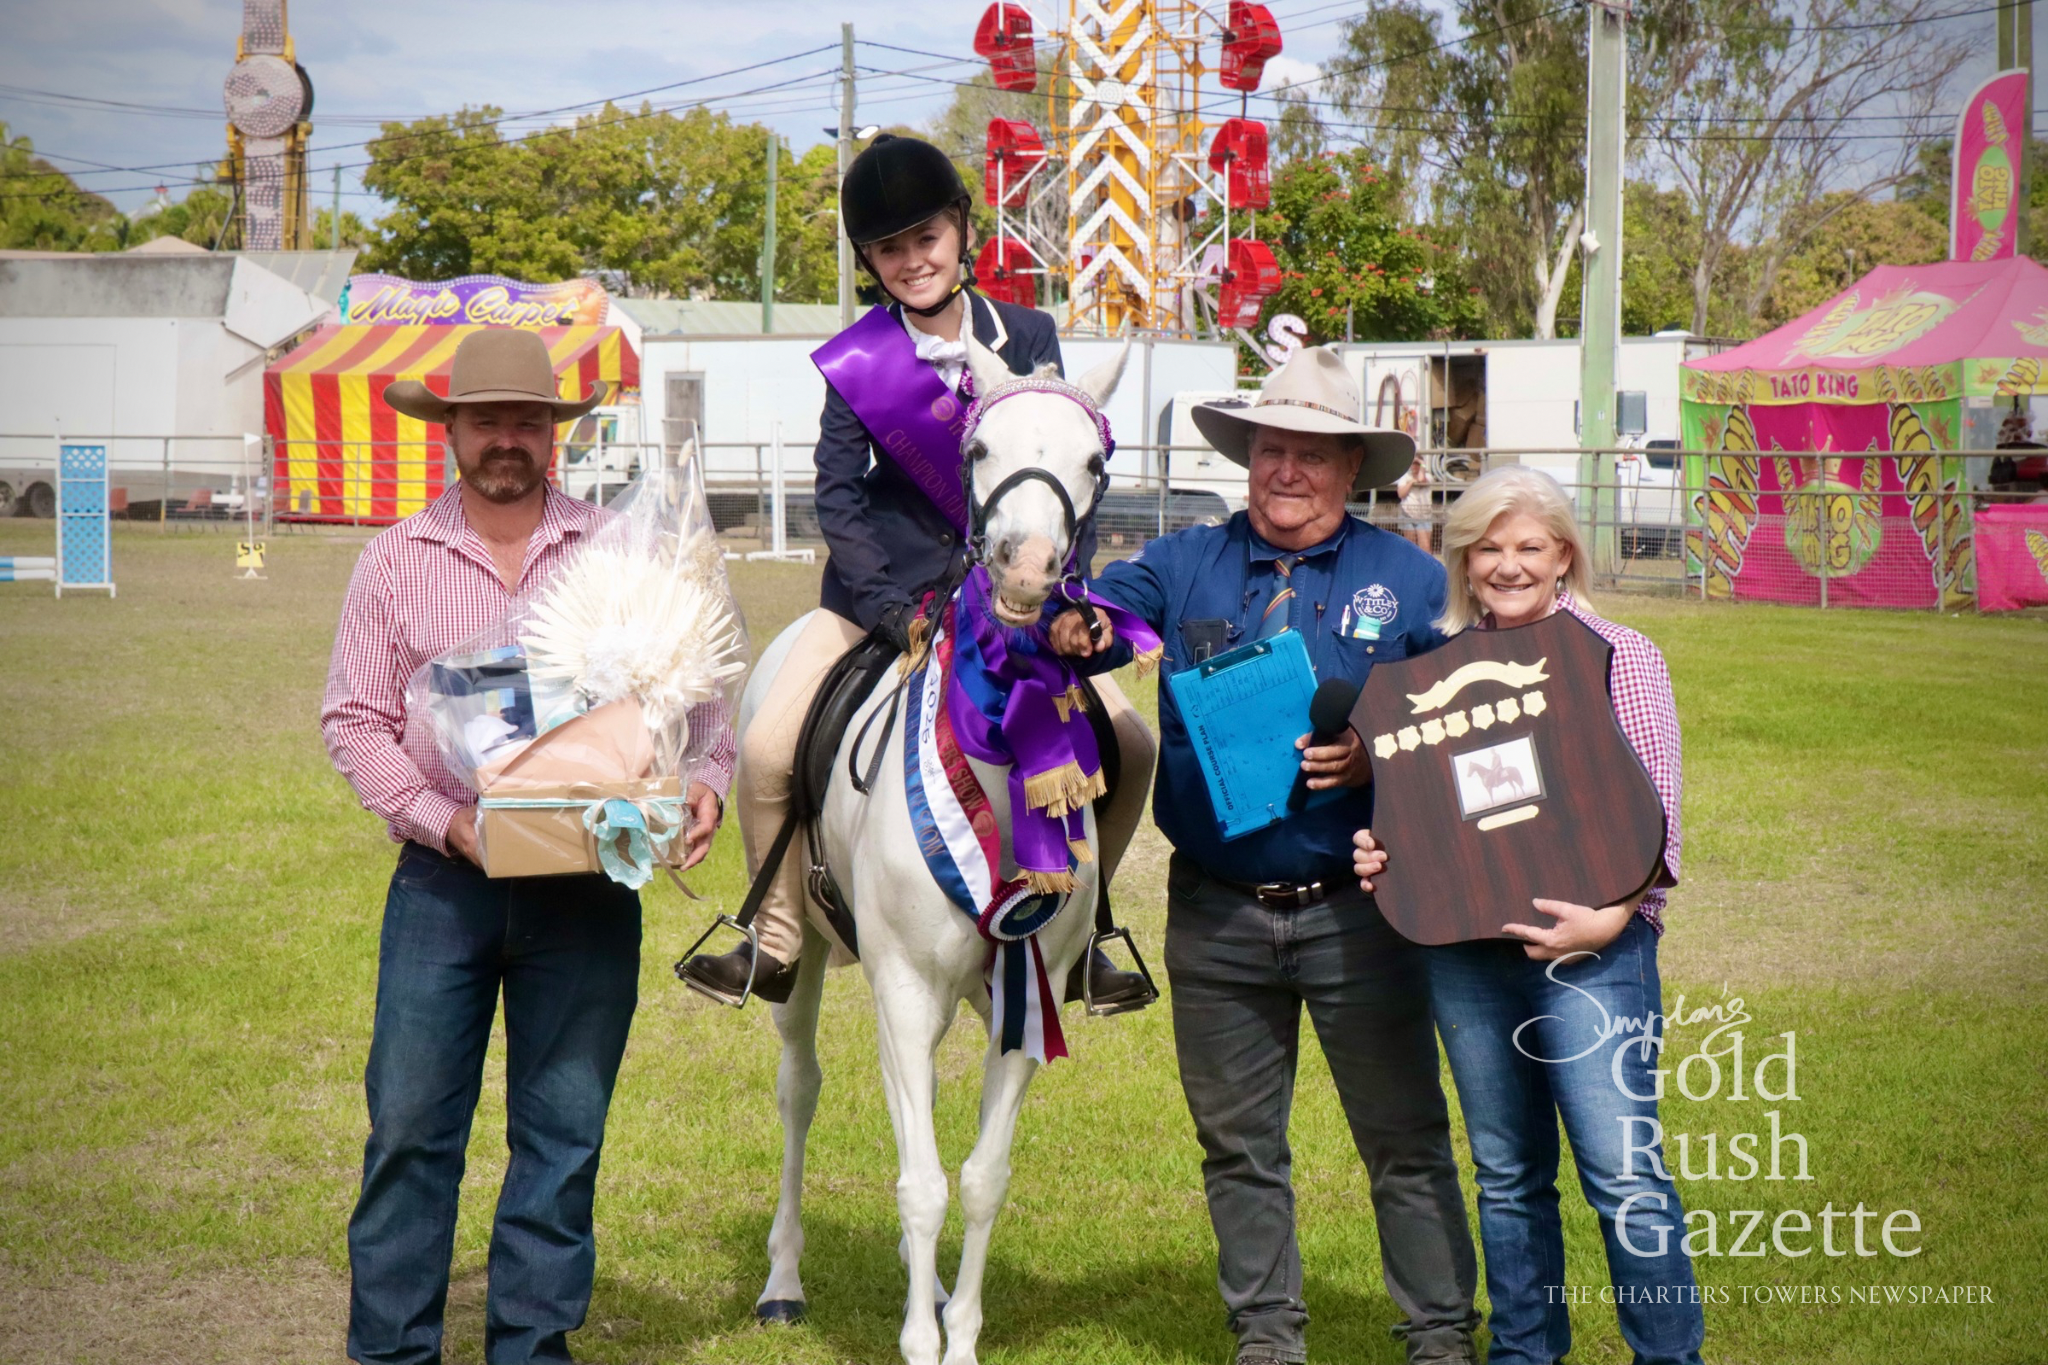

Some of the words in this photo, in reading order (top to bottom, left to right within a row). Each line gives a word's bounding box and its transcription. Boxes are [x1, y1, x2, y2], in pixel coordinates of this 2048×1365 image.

[1978, 164, 1994, 212] TATO
[1993, 166, 2009, 210] KING
[350, 285, 461, 325] Magic
[465, 286, 580, 325] Carpet
[1770, 373, 1810, 398] TATO
[1816, 373, 1859, 398] KING
[886, 429, 951, 499] CHAMPION
[1198, 724, 1209, 746] PLAN
[1206, 745, 1221, 777] COURSE
[950, 767, 986, 811] SHOW
[1218, 776, 1234, 811] OFFICIAL
